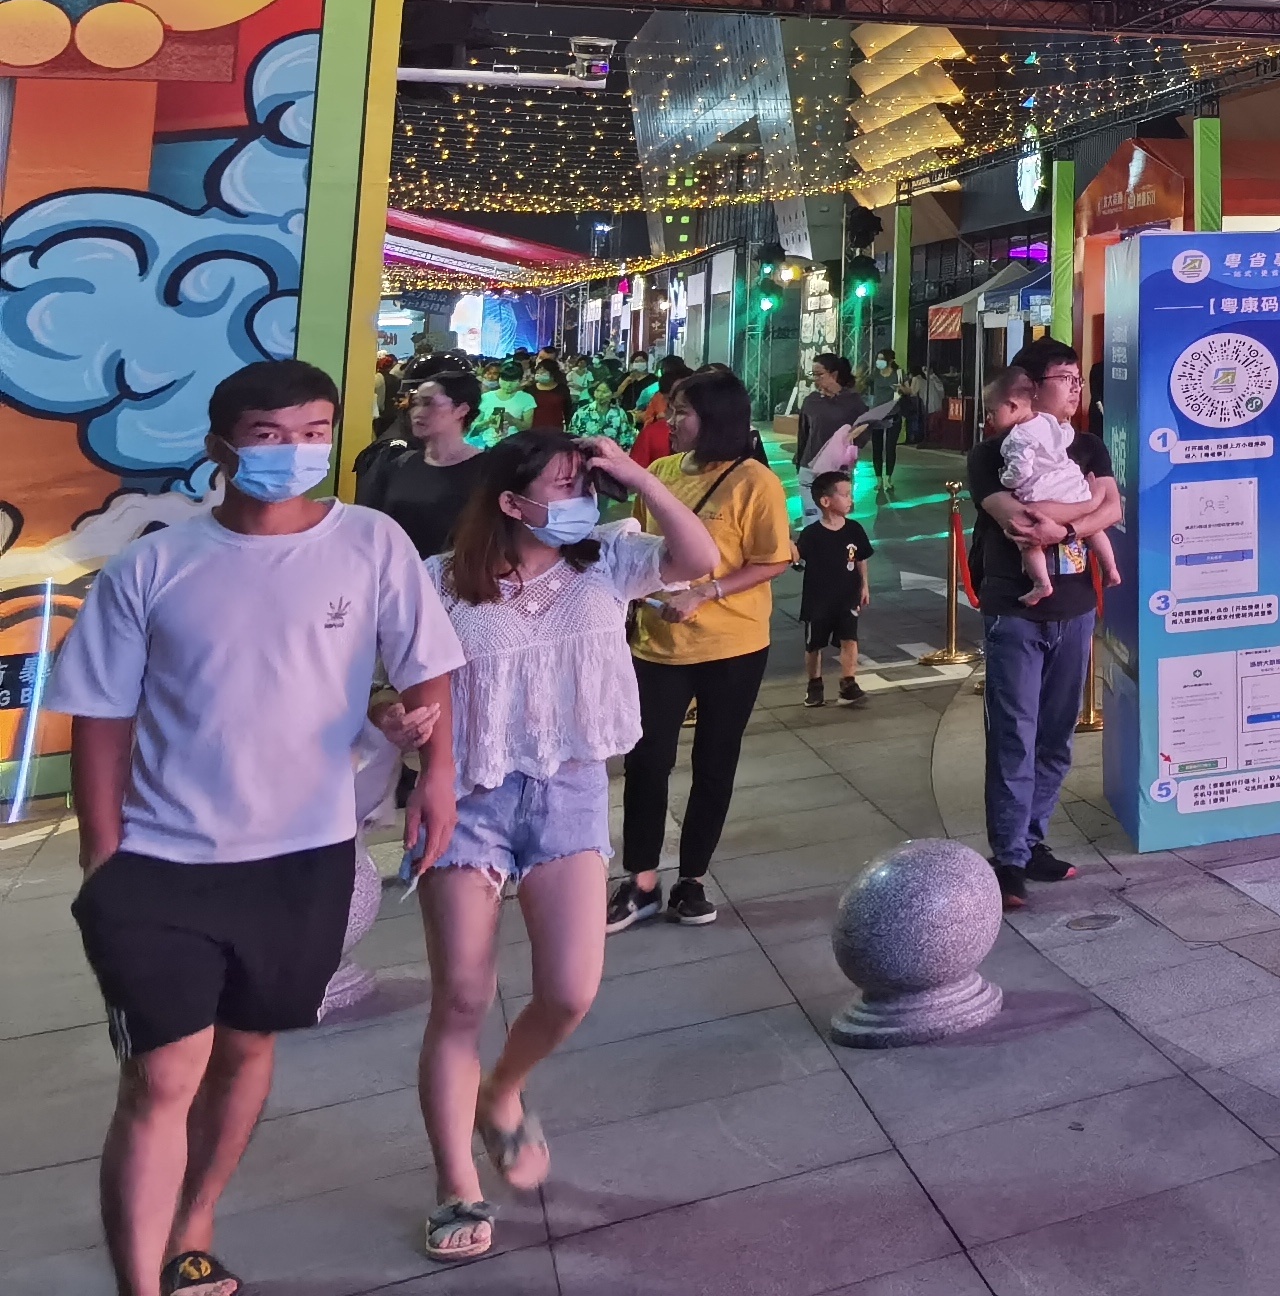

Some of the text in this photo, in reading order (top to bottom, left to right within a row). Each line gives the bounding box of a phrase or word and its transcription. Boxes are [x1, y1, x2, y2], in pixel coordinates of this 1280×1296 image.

[1157, 432, 1168, 448] 1
[1156, 594, 1170, 612] 3
[1157, 781, 1171, 799] 5
